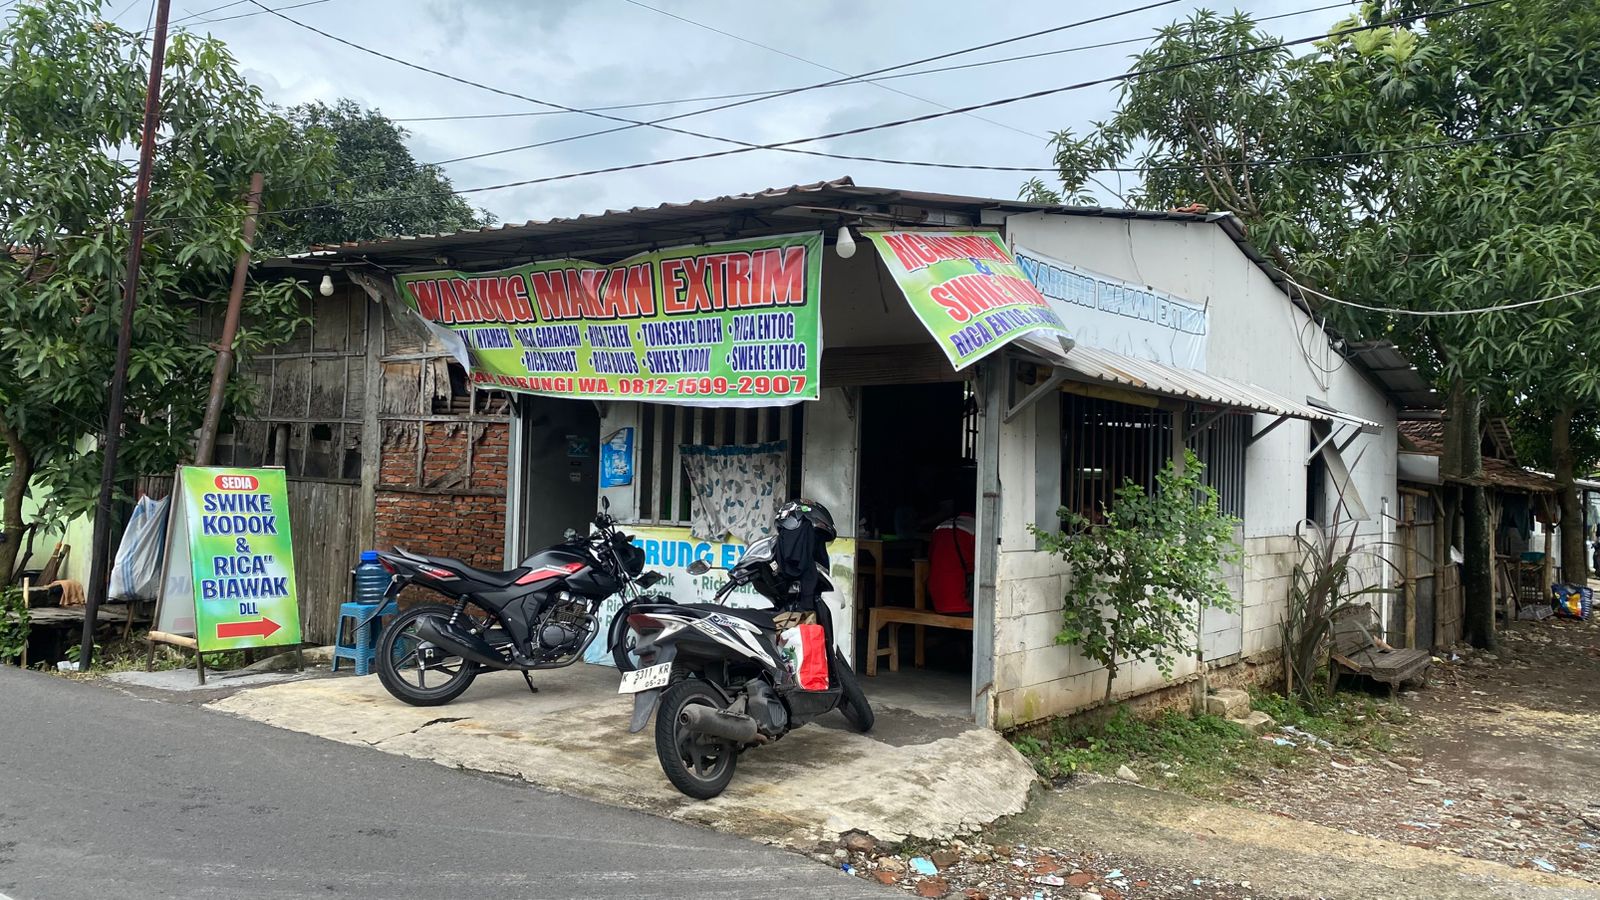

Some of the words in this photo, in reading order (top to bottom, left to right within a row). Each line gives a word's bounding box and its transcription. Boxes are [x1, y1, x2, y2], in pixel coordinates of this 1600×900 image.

[968, 257, 994, 276] &
[407, 276, 535, 324] WARUNG
[532, 263, 656, 322] MAKAN
[661, 245, 807, 315] EXTRIM
[1098, 280, 1155, 323] MAKAN
[536, 325, 582, 348] GARANGAN
[588, 325, 605, 347] RICA
[604, 325, 632, 347] TEKEK
[641, 319, 695, 347] TONGSENG
[697, 317, 723, 344] DIDEH
[733, 315, 756, 341] RICA
[758, 313, 794, 340] ENTOG
[950, 321, 994, 357] RICA
[985, 308, 1032, 337] ENTOG
[525, 350, 544, 372] RICA
[593, 351, 611, 373] RICA
[646, 349, 681, 373] SWEKE
[732, 344, 767, 371] SWEKE
[768, 343, 806, 370] ENTOG
[497, 373, 575, 393] HUBUNGI
[578, 378, 615, 394] WA.
[619, 375, 807, 395] 0812-1599-2907
[222, 475, 253, 490] SEDIA
[203, 493, 273, 514] SWIKE
[202, 515, 278, 536] KODOK
[235, 537, 252, 553] &
[202, 577, 289, 600] BIAWAK
[239, 602, 259, 616] DLL
